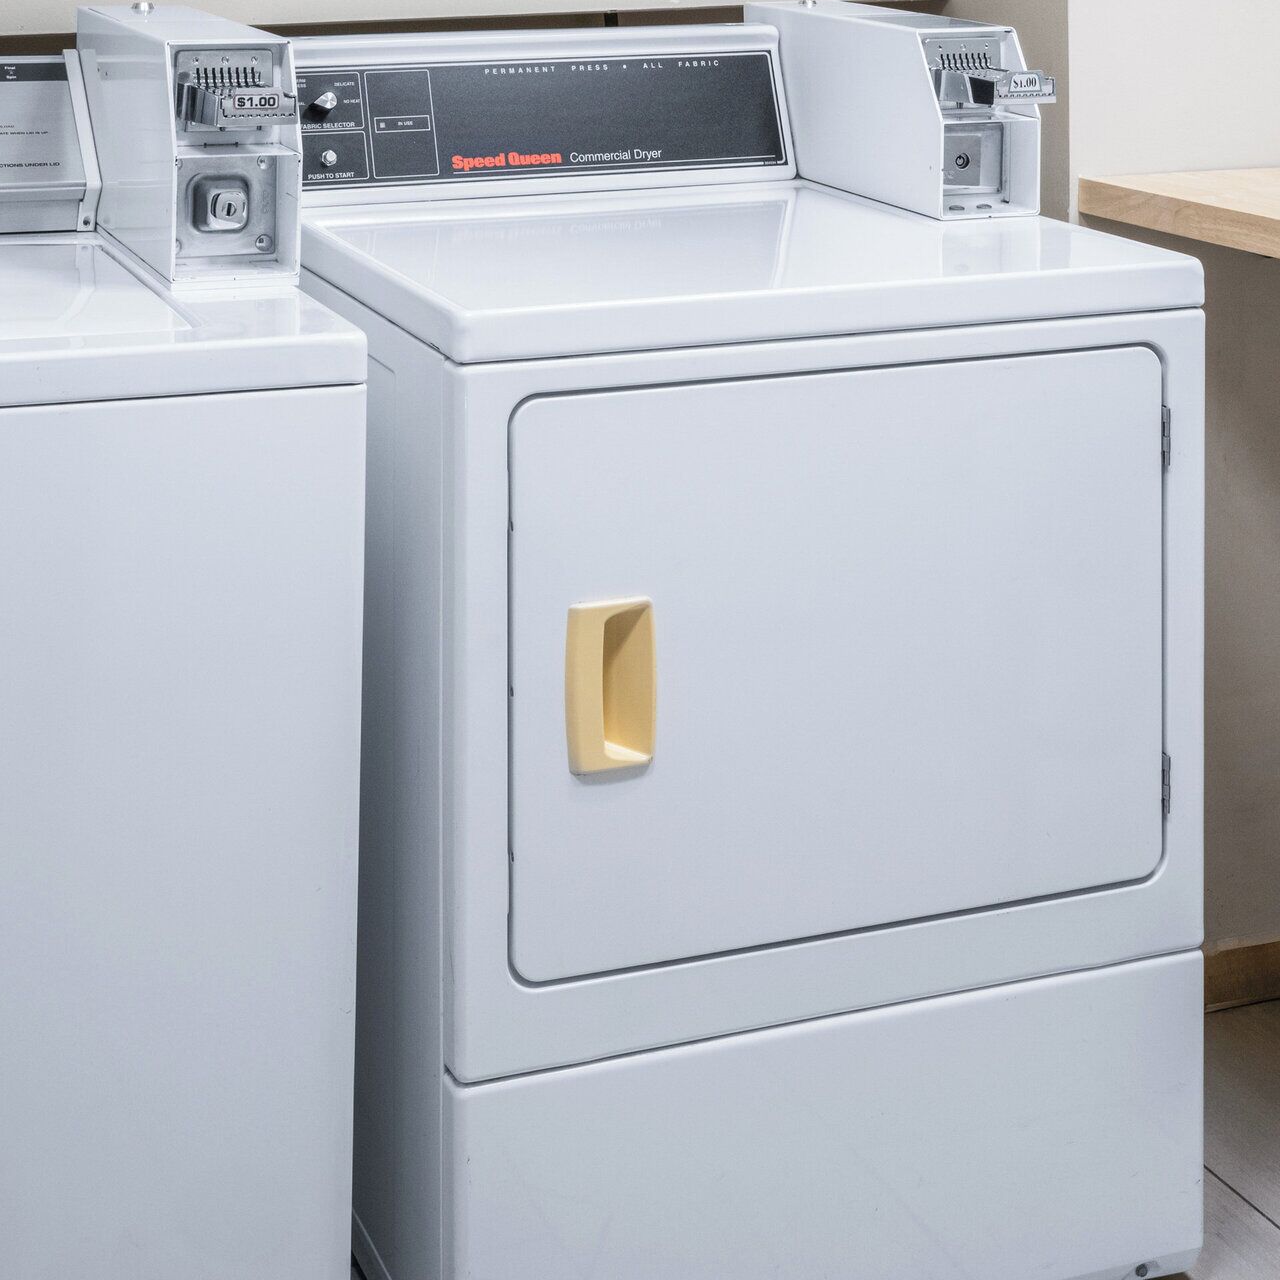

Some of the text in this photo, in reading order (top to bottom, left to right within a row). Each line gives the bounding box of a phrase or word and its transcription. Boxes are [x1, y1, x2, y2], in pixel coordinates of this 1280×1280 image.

[484, 66, 556, 75] PERMANENT
[643, 61, 663, 69] ALL
[678, 59, 719, 67] FABRIC
[1013, 77, 1037, 89] $1.00
[237, 96, 276, 107] $1.00
[451, 148, 663, 171] Speed Queen Commercial Dryer
